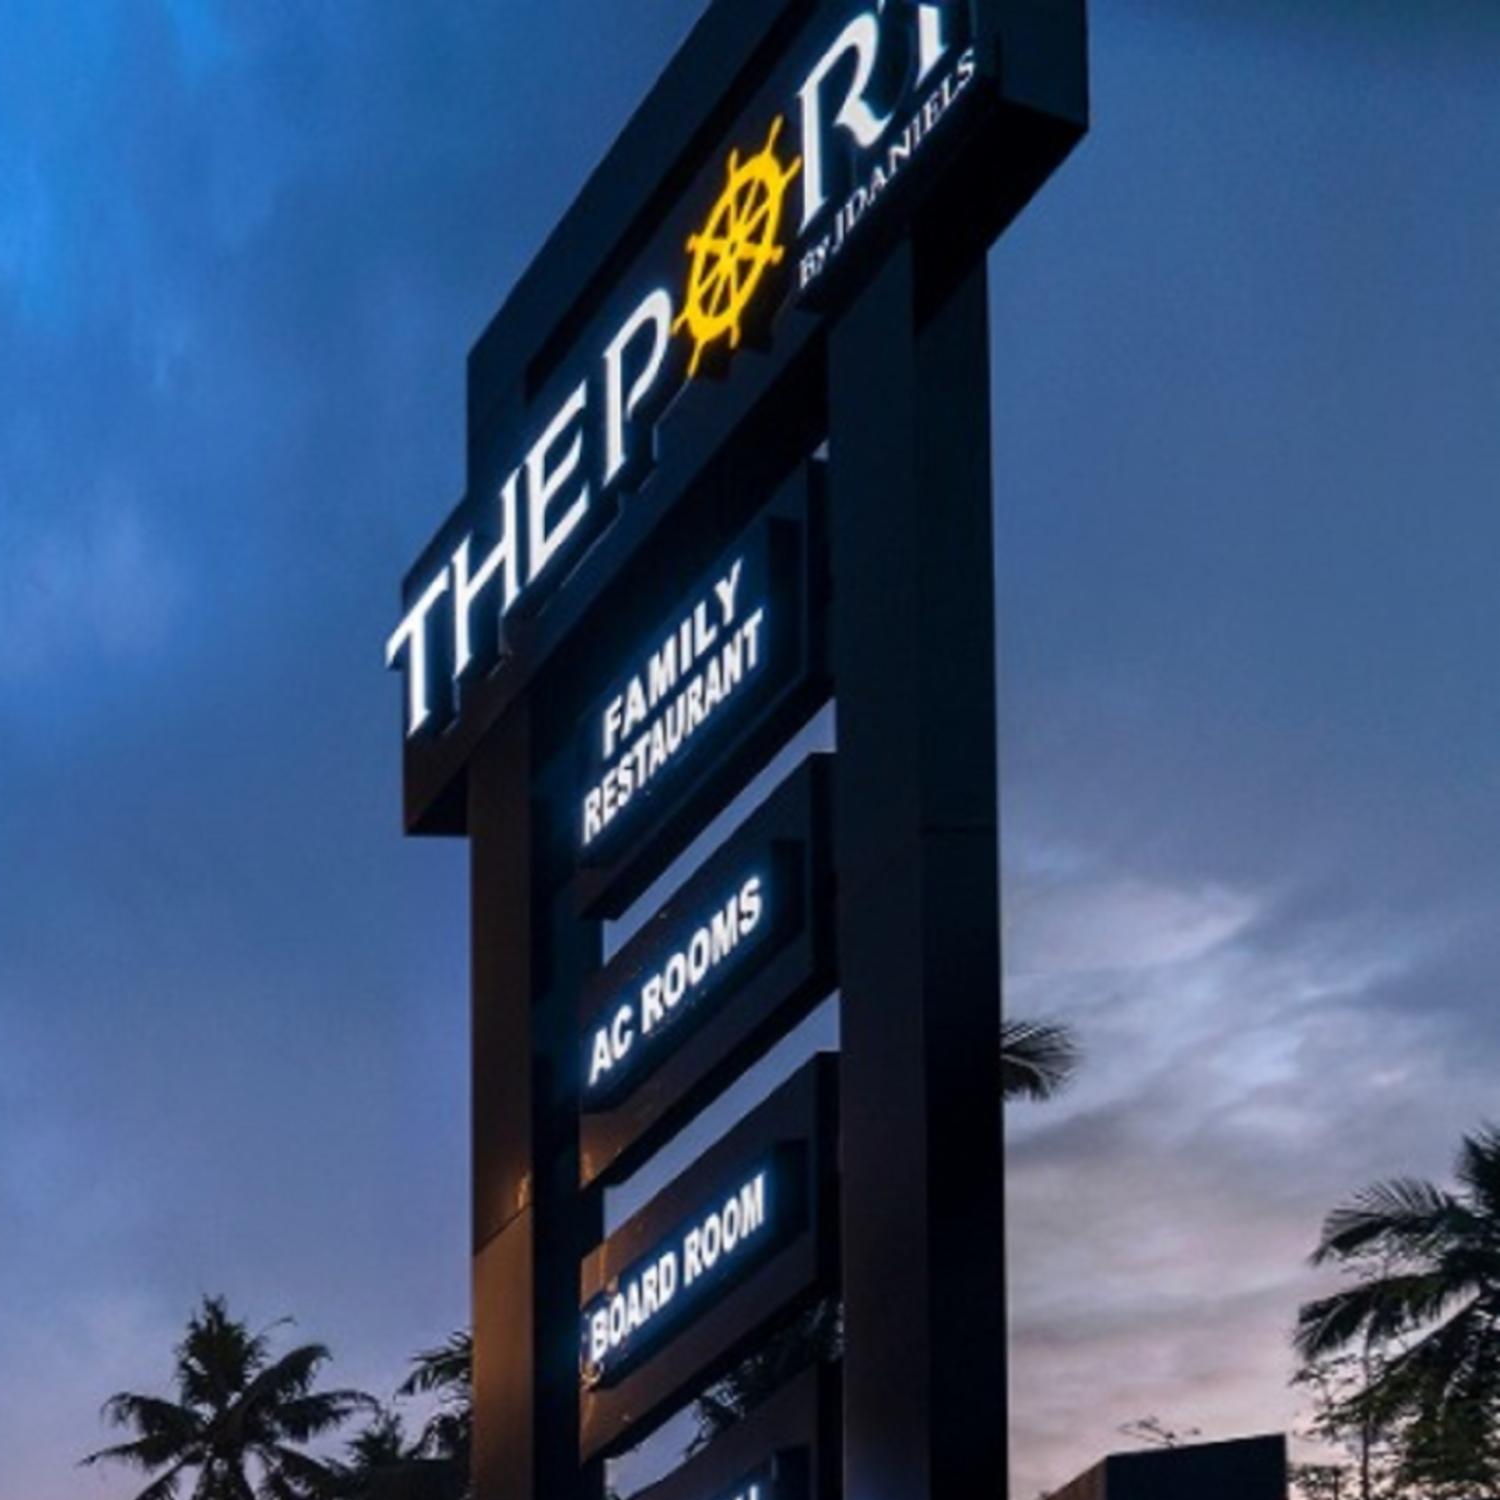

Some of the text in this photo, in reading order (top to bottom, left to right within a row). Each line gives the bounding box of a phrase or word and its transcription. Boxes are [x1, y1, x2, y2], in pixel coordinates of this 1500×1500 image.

[831, 47, 976, 255] JDANIELS
[385, 378, 590, 738] THE
[602, 558, 743, 760] FAMILY
[582, 606, 764, 846] RESTAURANT
[588, 875, 763, 1087] AC ROOMS
[588, 1173, 766, 1369] BOARD ROOM
